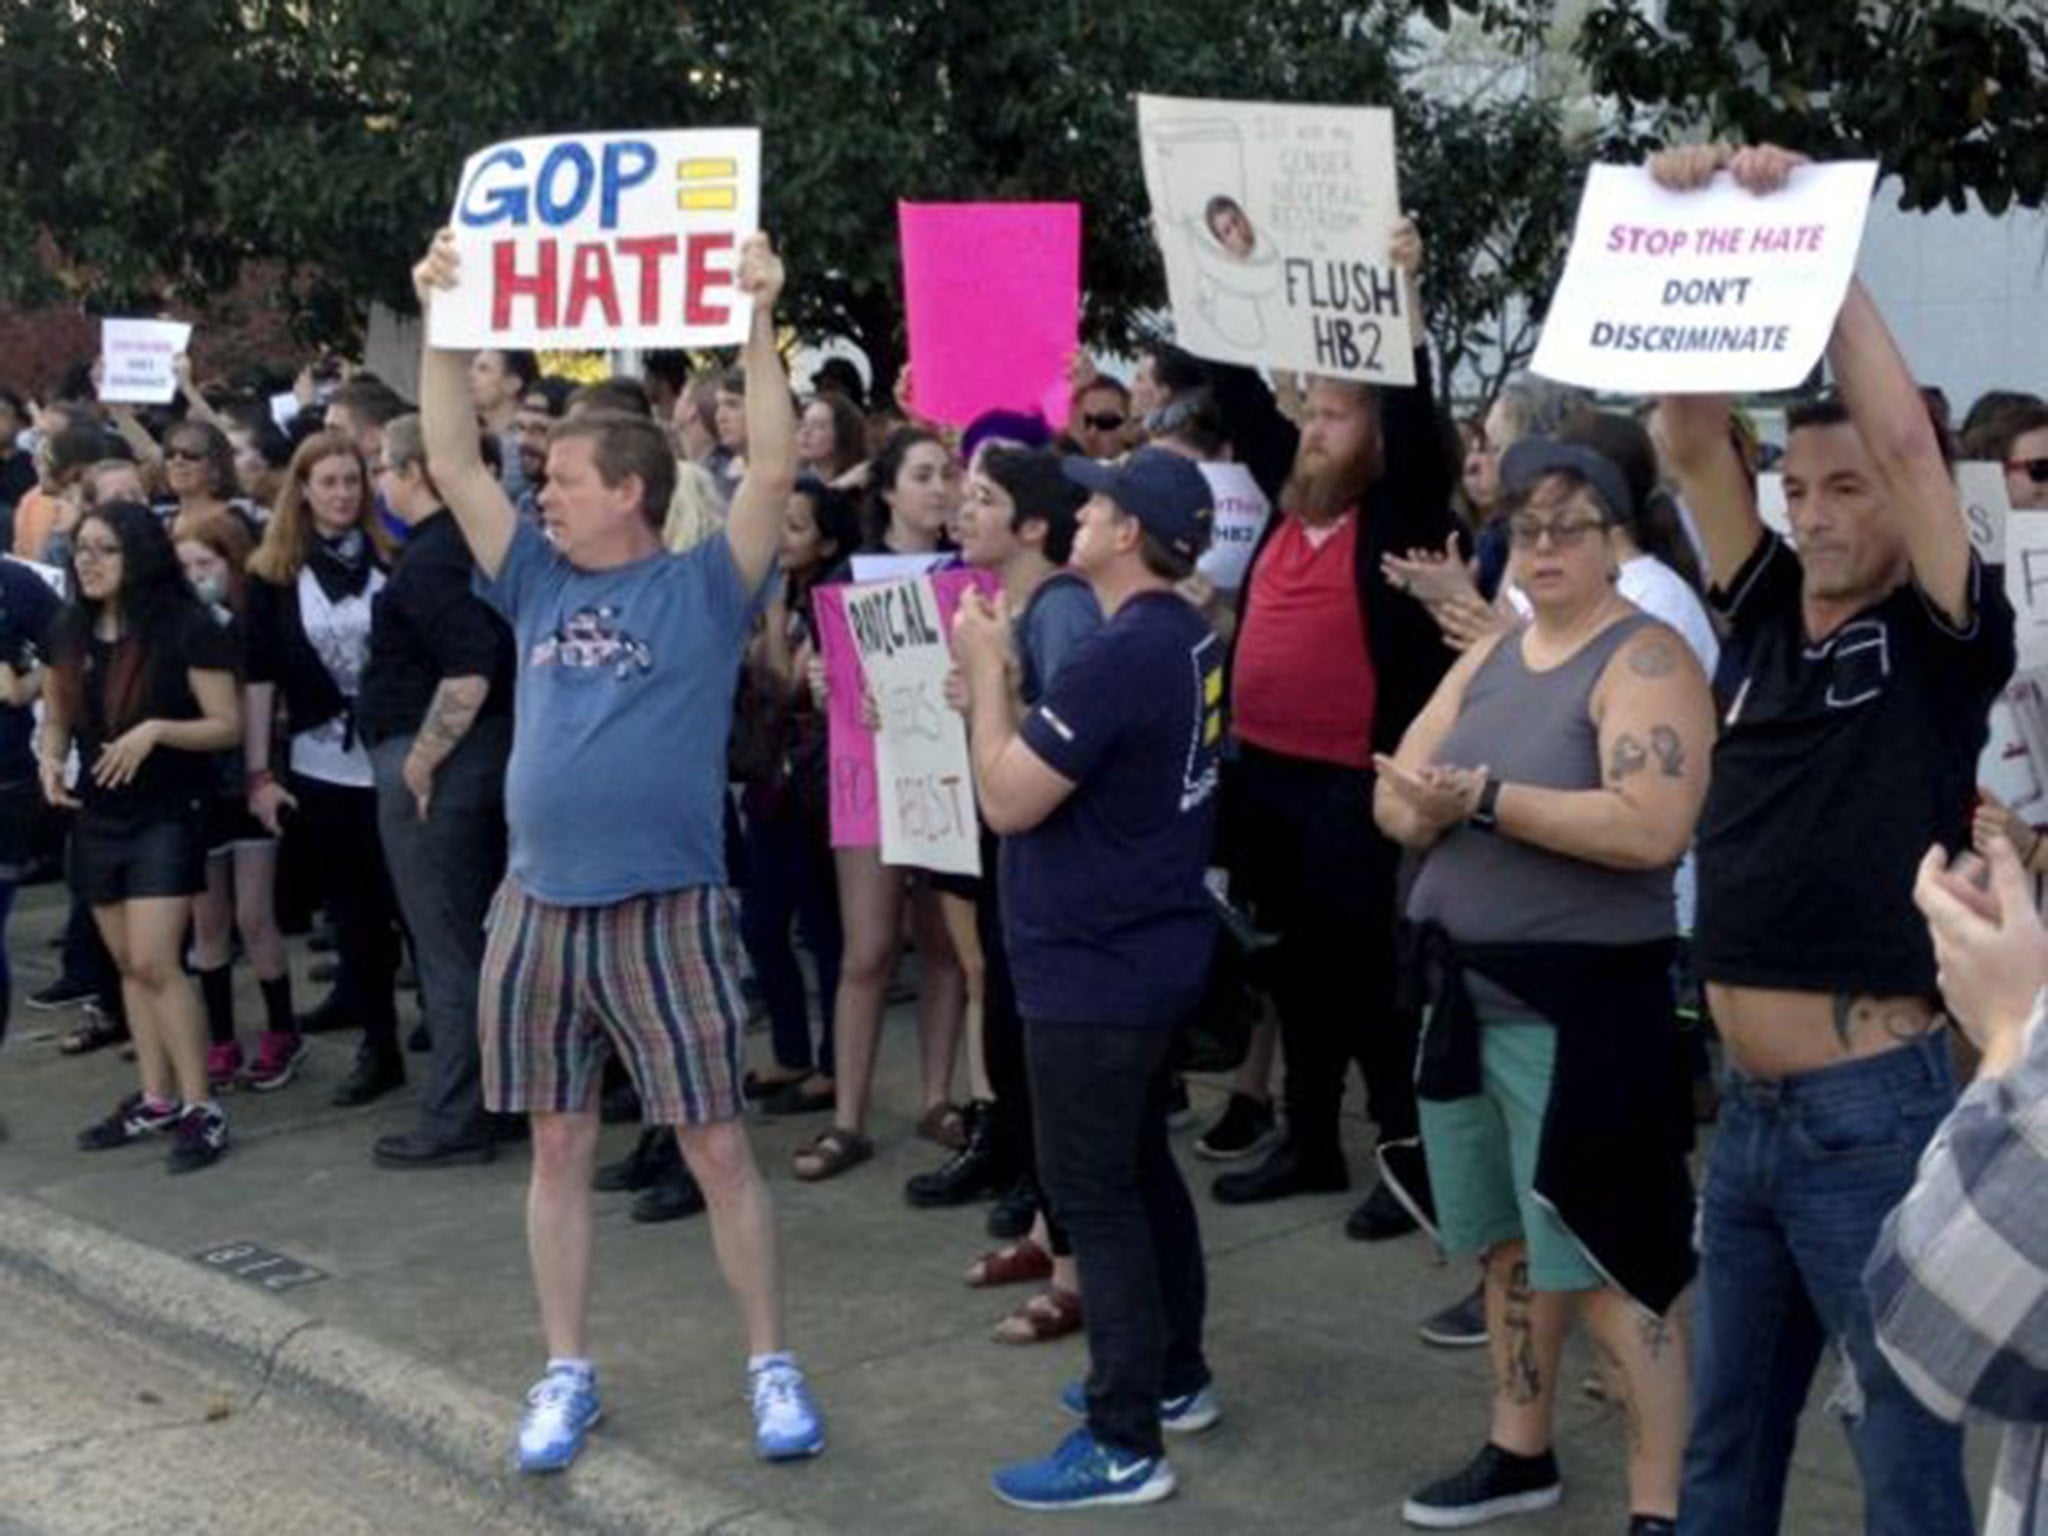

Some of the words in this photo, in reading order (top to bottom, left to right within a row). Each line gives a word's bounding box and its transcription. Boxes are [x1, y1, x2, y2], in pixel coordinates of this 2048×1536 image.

[459, 141, 658, 229] GOP
[1606, 224, 1688, 257] STOP
[1695, 226, 1744, 253] THE
[1750, 224, 1825, 251] HATE
[491, 232, 734, 332] HATE
[1285, 258, 1400, 316] FLUSH
[1661, 276, 1752, 306] DON'T
[1314, 316, 1383, 371] HB2
[1589, 321, 1790, 352] DISCRIMINATE
